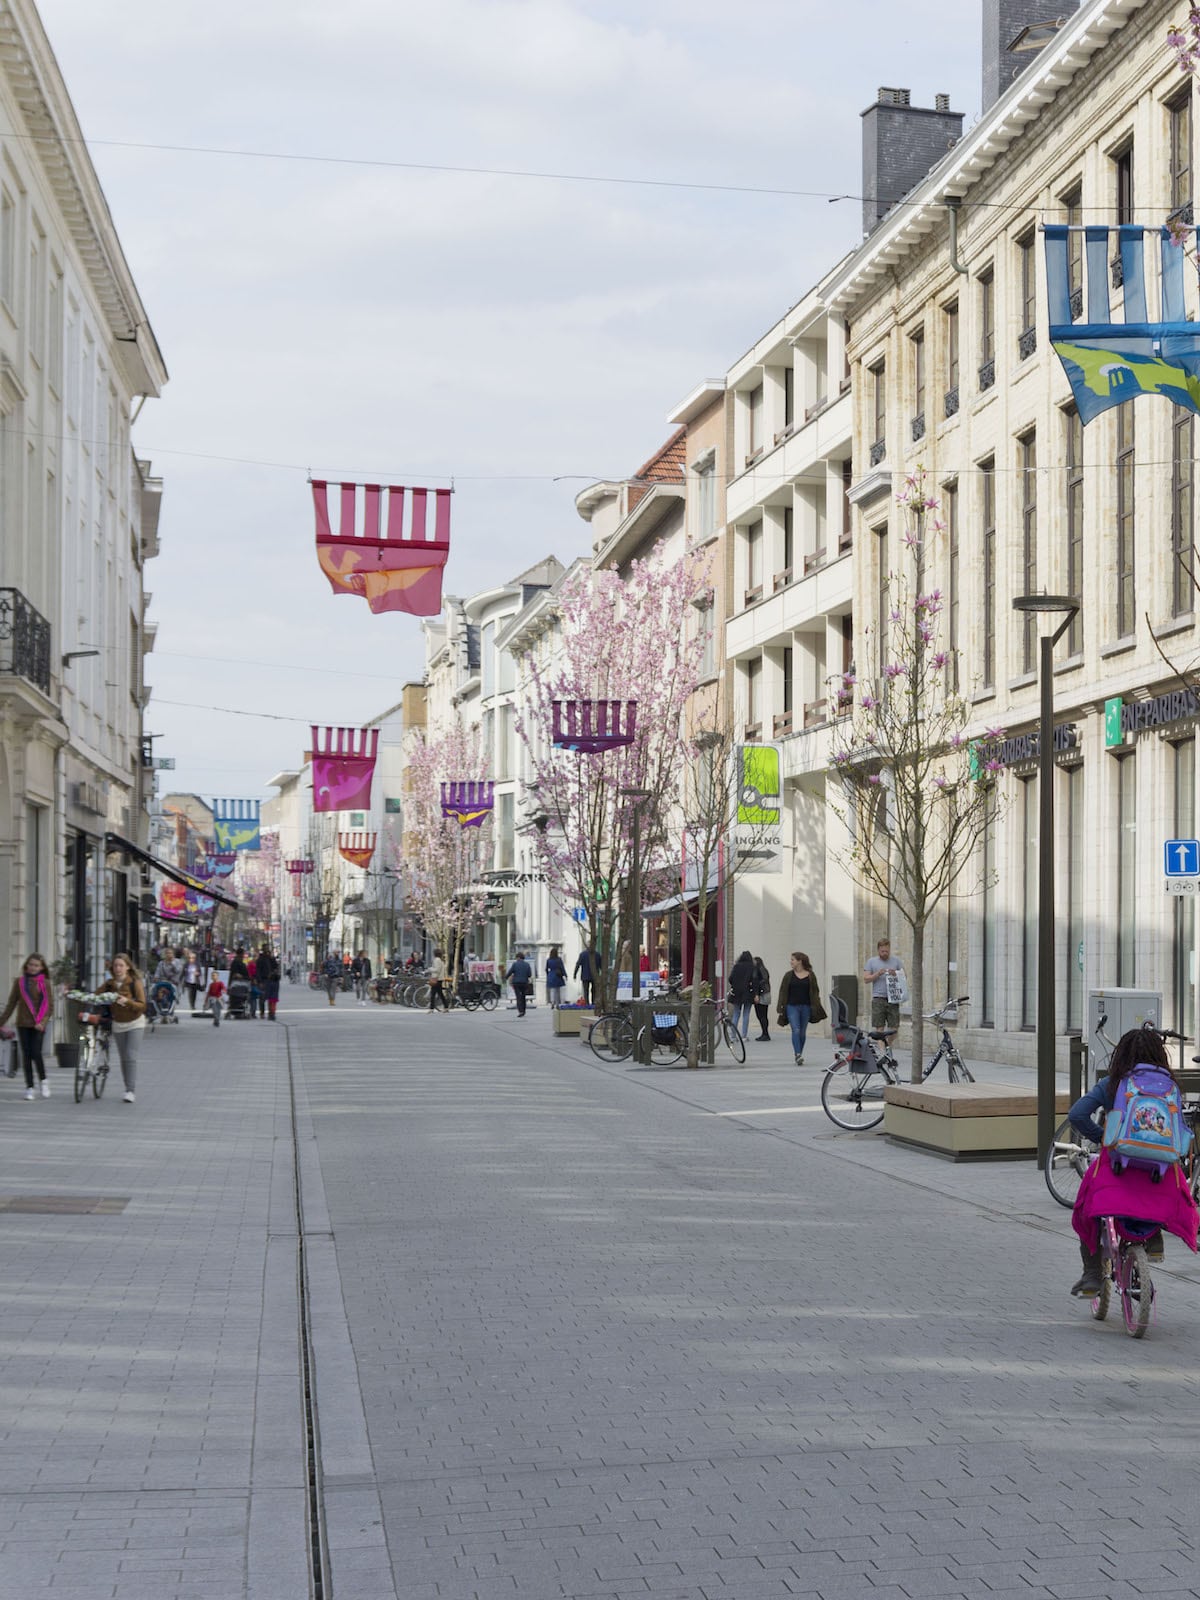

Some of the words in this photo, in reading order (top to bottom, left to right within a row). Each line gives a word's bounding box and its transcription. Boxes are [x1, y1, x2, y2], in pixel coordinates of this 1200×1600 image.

[1120, 702, 1144, 732] BNP
[1145, 689, 1197, 727] PARIBAS
[736, 836, 780, 845] INGANG
[515, 873, 549, 883] ZARA
